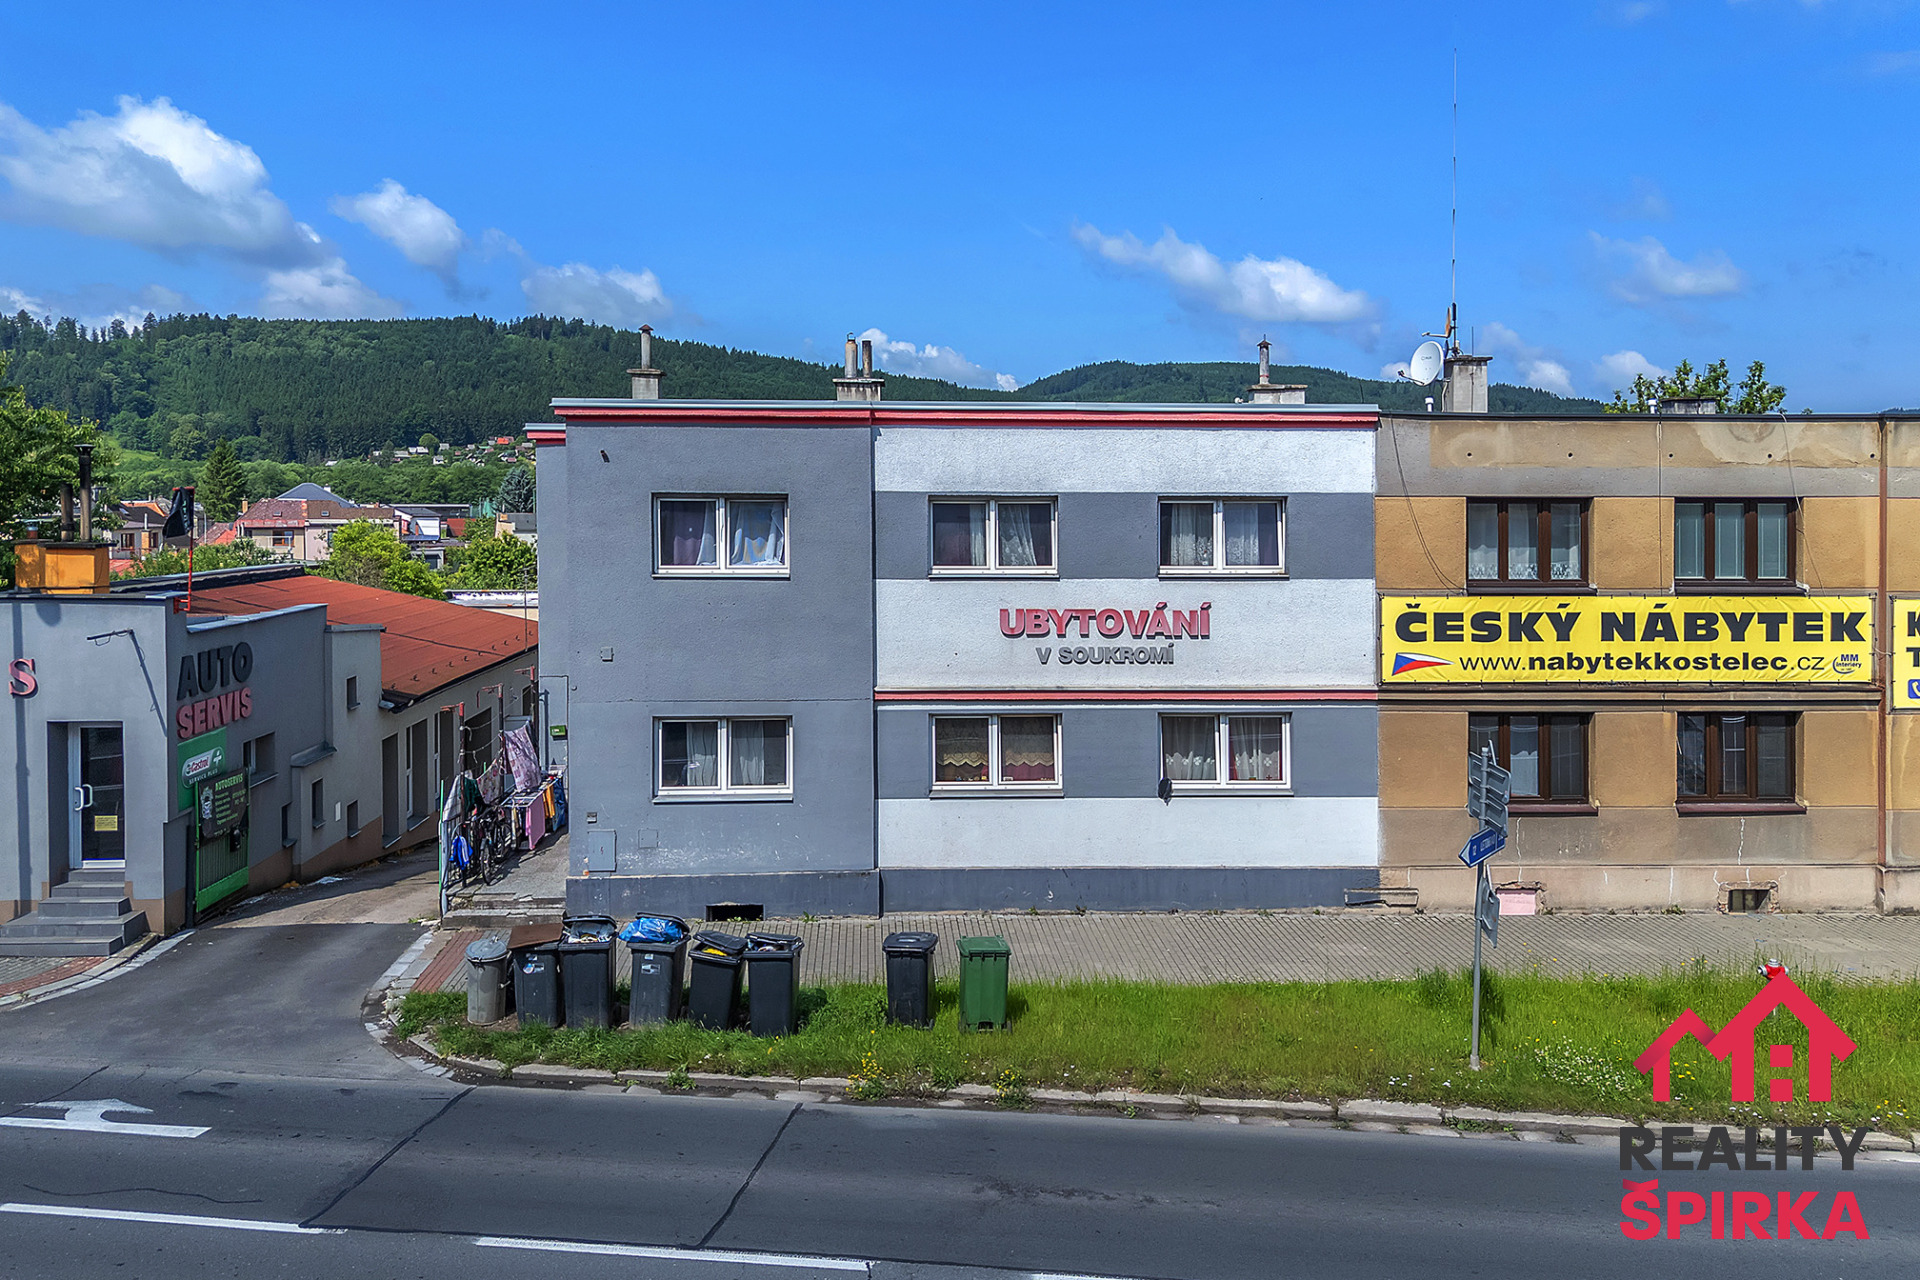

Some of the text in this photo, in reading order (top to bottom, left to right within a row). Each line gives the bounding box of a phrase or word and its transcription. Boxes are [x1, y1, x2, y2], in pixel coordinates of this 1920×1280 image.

[999, 602, 1211, 639] UBYTOVÁNÍ
[1395, 603, 1581, 642] ČESKÝ
[1601, 603, 1866, 642] NÁBYTEK
[176, 642, 253, 700] AUTO
[1036, 643, 1174, 664] V SOUKROMÍ
[1460, 652, 1825, 674] www.nabytekkostelec.cz
[8, 658, 38, 699] S
[176, 687, 253, 739] SERVIS
